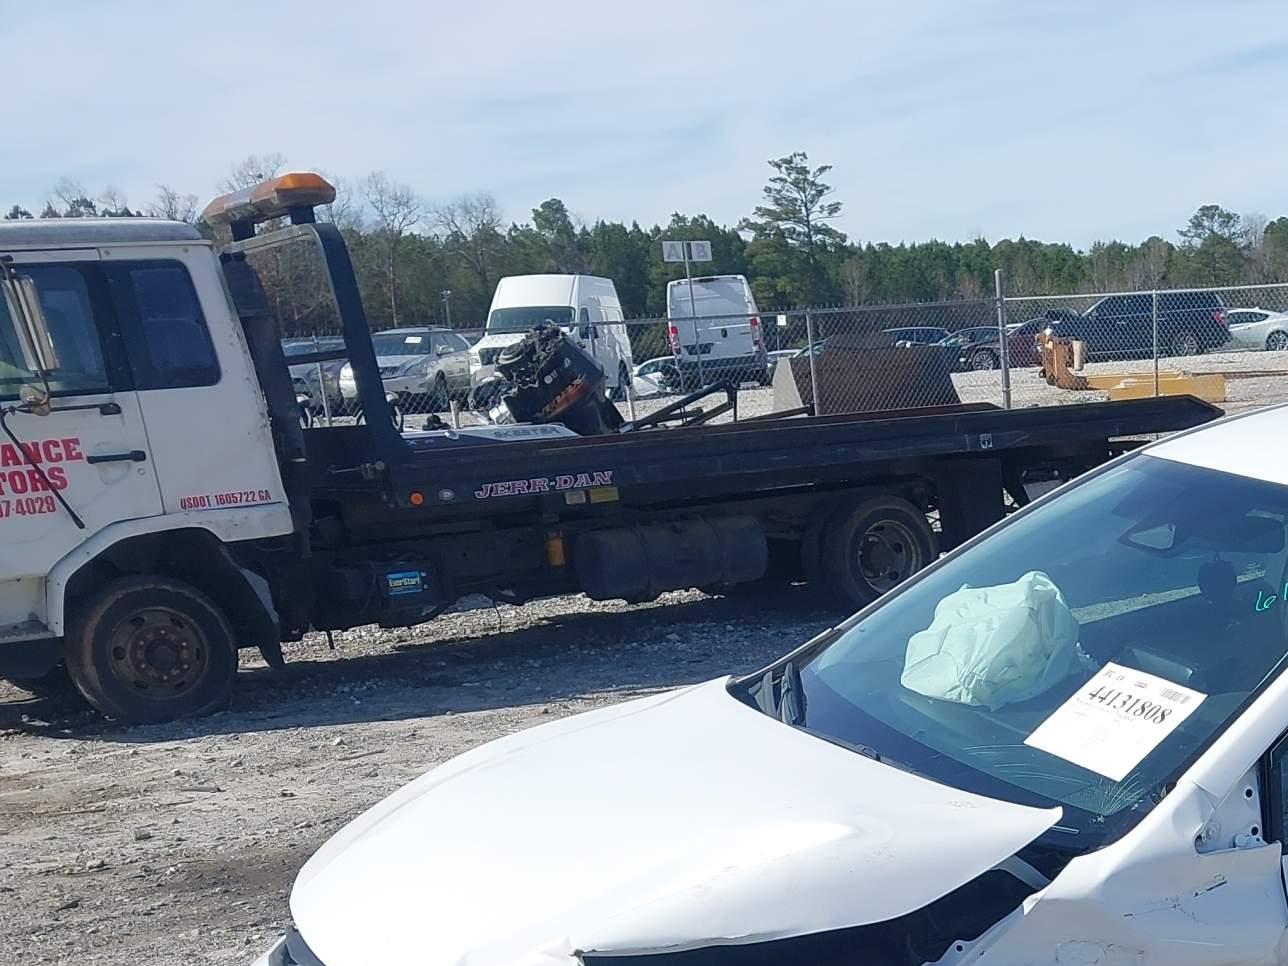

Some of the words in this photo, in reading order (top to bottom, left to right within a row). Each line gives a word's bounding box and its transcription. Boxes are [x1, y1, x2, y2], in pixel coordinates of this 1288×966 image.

[666, 243, 681, 260] A
[695, 243, 707, 259] B
[0, 437, 84, 467] ANCE
[474, 470, 614, 499] JERR-DAN
[180, 494, 212, 511] USDOT
[215, 491, 257, 506] 1605722
[258, 489, 272, 502] GA
[1087, 685, 1173, 725] 44131808
